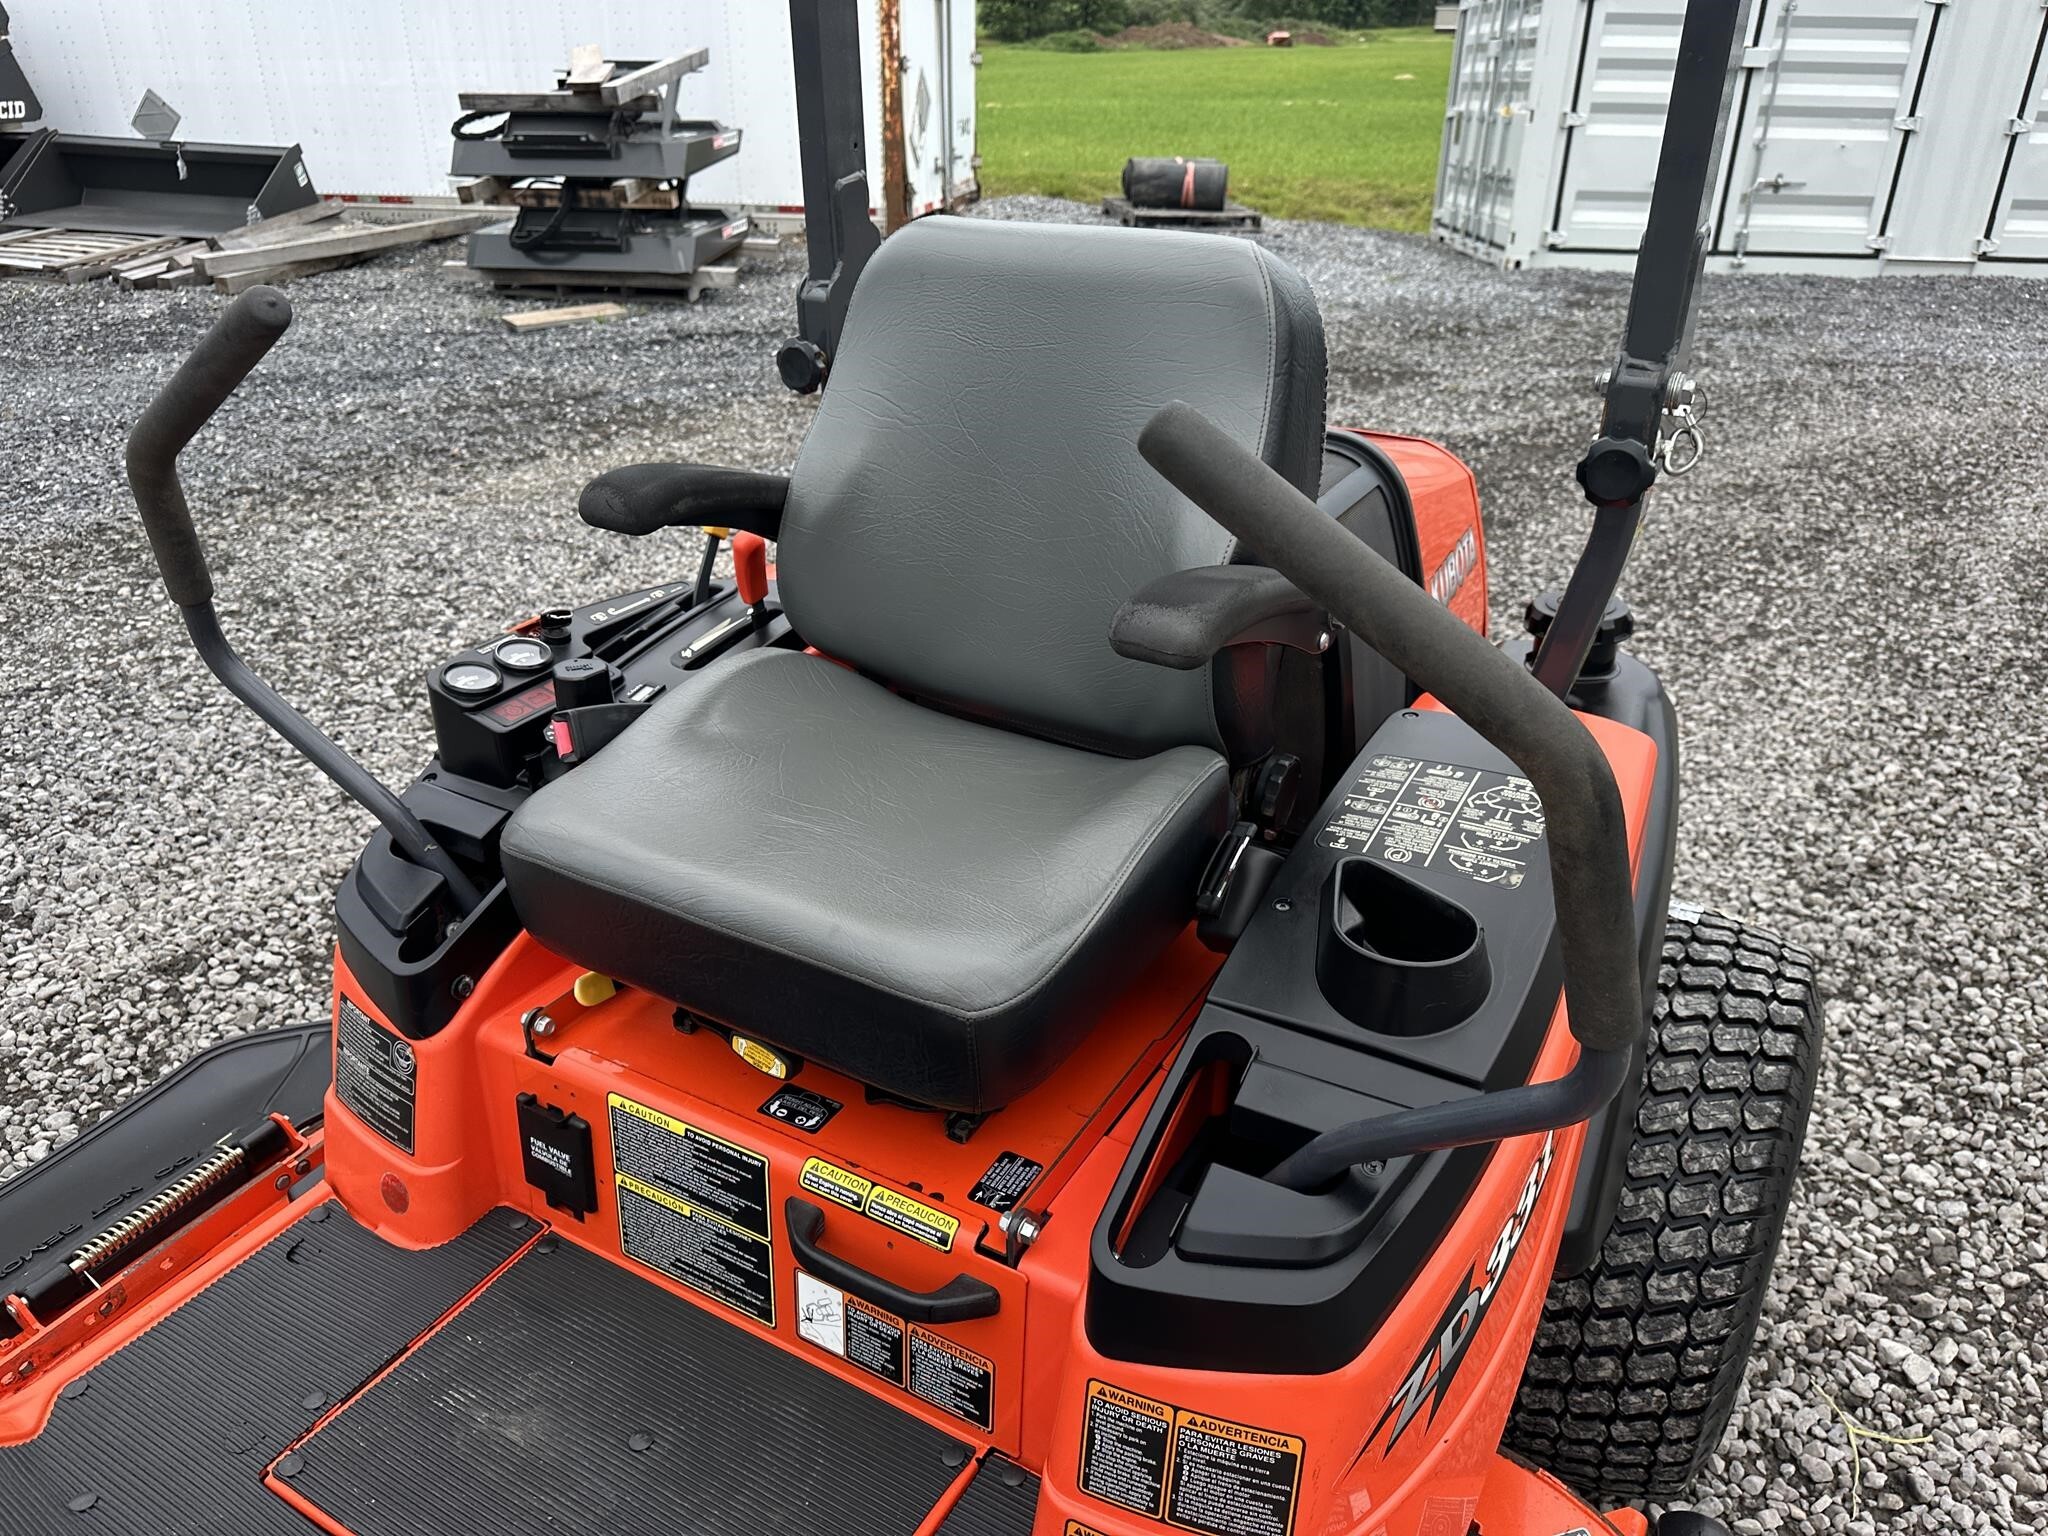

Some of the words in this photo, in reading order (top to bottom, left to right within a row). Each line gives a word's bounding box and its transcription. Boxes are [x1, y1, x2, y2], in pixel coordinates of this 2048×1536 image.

[1431, 527, 1476, 606] KUBOTA
[627, 1102, 670, 1128] CAUTION
[530, 1136, 548, 1151] FUEL
[548, 1145, 571, 1163] VALVE
[818, 1164, 868, 1193] CAUTION
[627, 1179, 684, 1213] PRECAUCIÓN
[0, 1222, 84, 1278] REMO
[847, 1304, 855, 1314] TO
[855, 1309, 873, 1322] AVOID
[874, 1317, 900, 1335] SERIOUS
[855, 1298, 899, 1326] WARNING
[920, 1329, 989, 1370] ADVERTENCIA
[1091, 1403, 1120, 1419] INJURY
[1121, 1414, 1134, 1424] OR
[1134, 1419, 1163, 1434] DEATH
[1092, 1397, 1104, 1407] TO
[1103, 1401, 1129, 1416] AVOID
[1130, 1410, 1167, 1429] SERIOUS
[1107, 1389, 1164, 1417] WARNING
[1178, 1433, 1238, 1455] PERSONALES
[1238, 1449, 1276, 1464] GRAVES
[1179, 1427, 1203, 1439] PARA
[1204, 1433, 1236, 1448] EVITAR
[1236, 1442, 1282, 1459] LESIONES
[1198, 1418, 1290, 1450] ADVERTENCIA
[1177, 1439, 1185, 1447] O
[1186, 1442, 1199, 1451] LA
[1199, 1446, 1236, 1461] MUERTE
